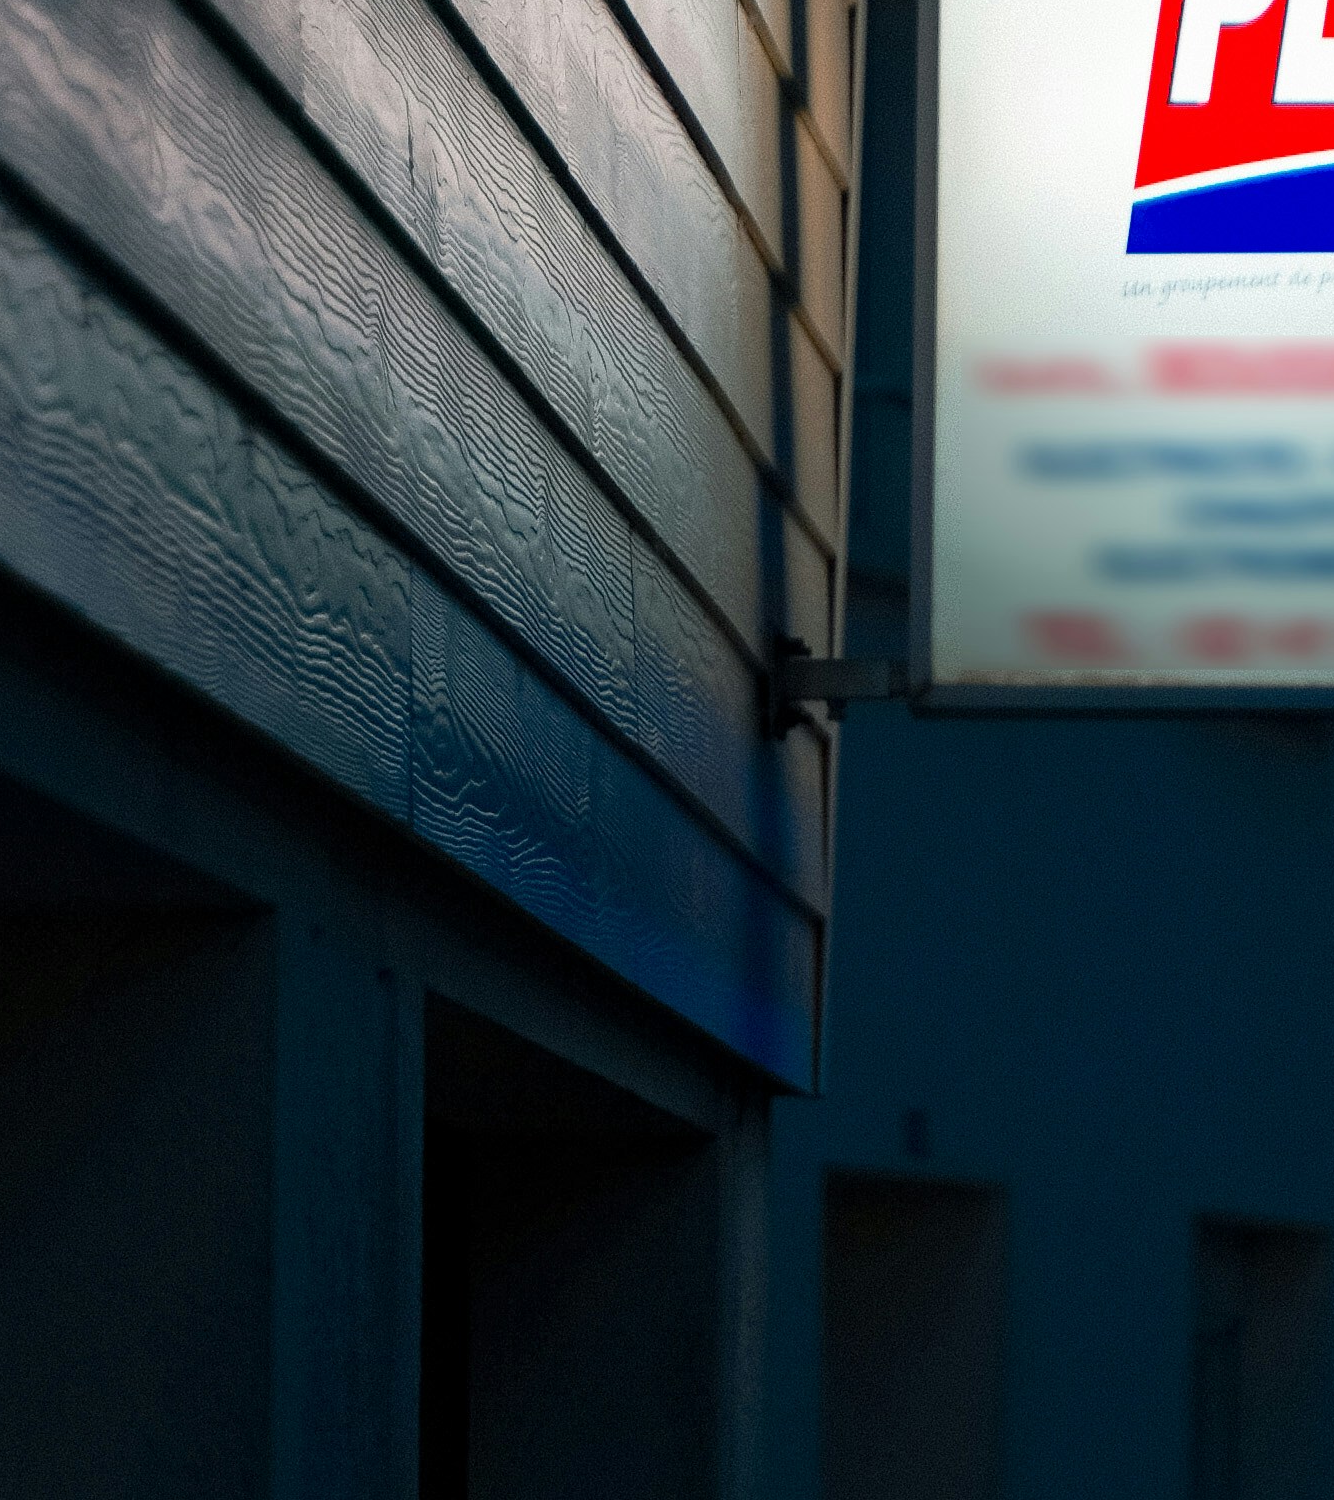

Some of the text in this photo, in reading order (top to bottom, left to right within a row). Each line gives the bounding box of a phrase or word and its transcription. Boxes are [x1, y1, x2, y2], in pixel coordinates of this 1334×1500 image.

[1121, 279, 1154, 298] Un
[1159, 270, 1282, 306] groupement
[1288, 264, 1313, 286] de
